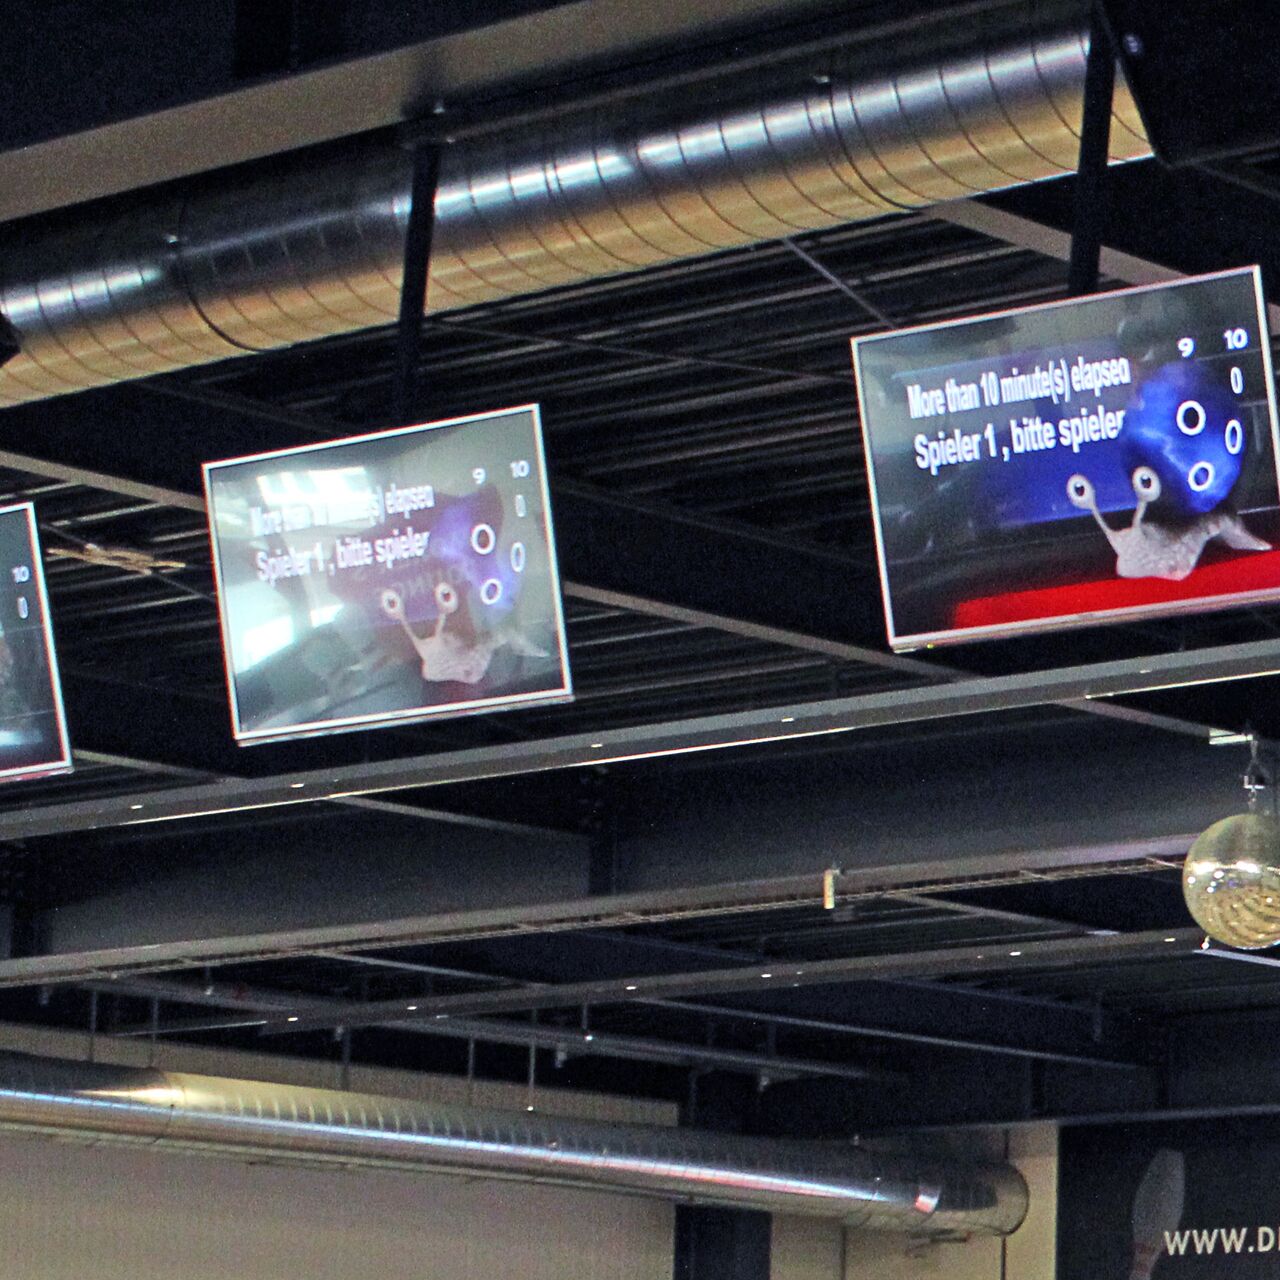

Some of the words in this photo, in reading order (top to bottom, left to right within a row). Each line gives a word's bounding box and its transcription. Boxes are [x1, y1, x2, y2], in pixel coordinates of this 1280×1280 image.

[1178, 337, 1195, 357] 9
[1224, 328, 1247, 349] 10
[907, 384, 946, 418] More
[946, 378, 980, 413] than
[980, 371, 1000, 406] 10
[1000, 358, 1070, 404] minute(s)
[1230, 366, 1243, 394] 0
[914, 429, 981, 475] Spieler
[1010, 415, 1056, 453] bitte
[472, 467, 486, 485] 9
[510, 460, 530, 478] 10
[12, 565, 30, 584] 10
